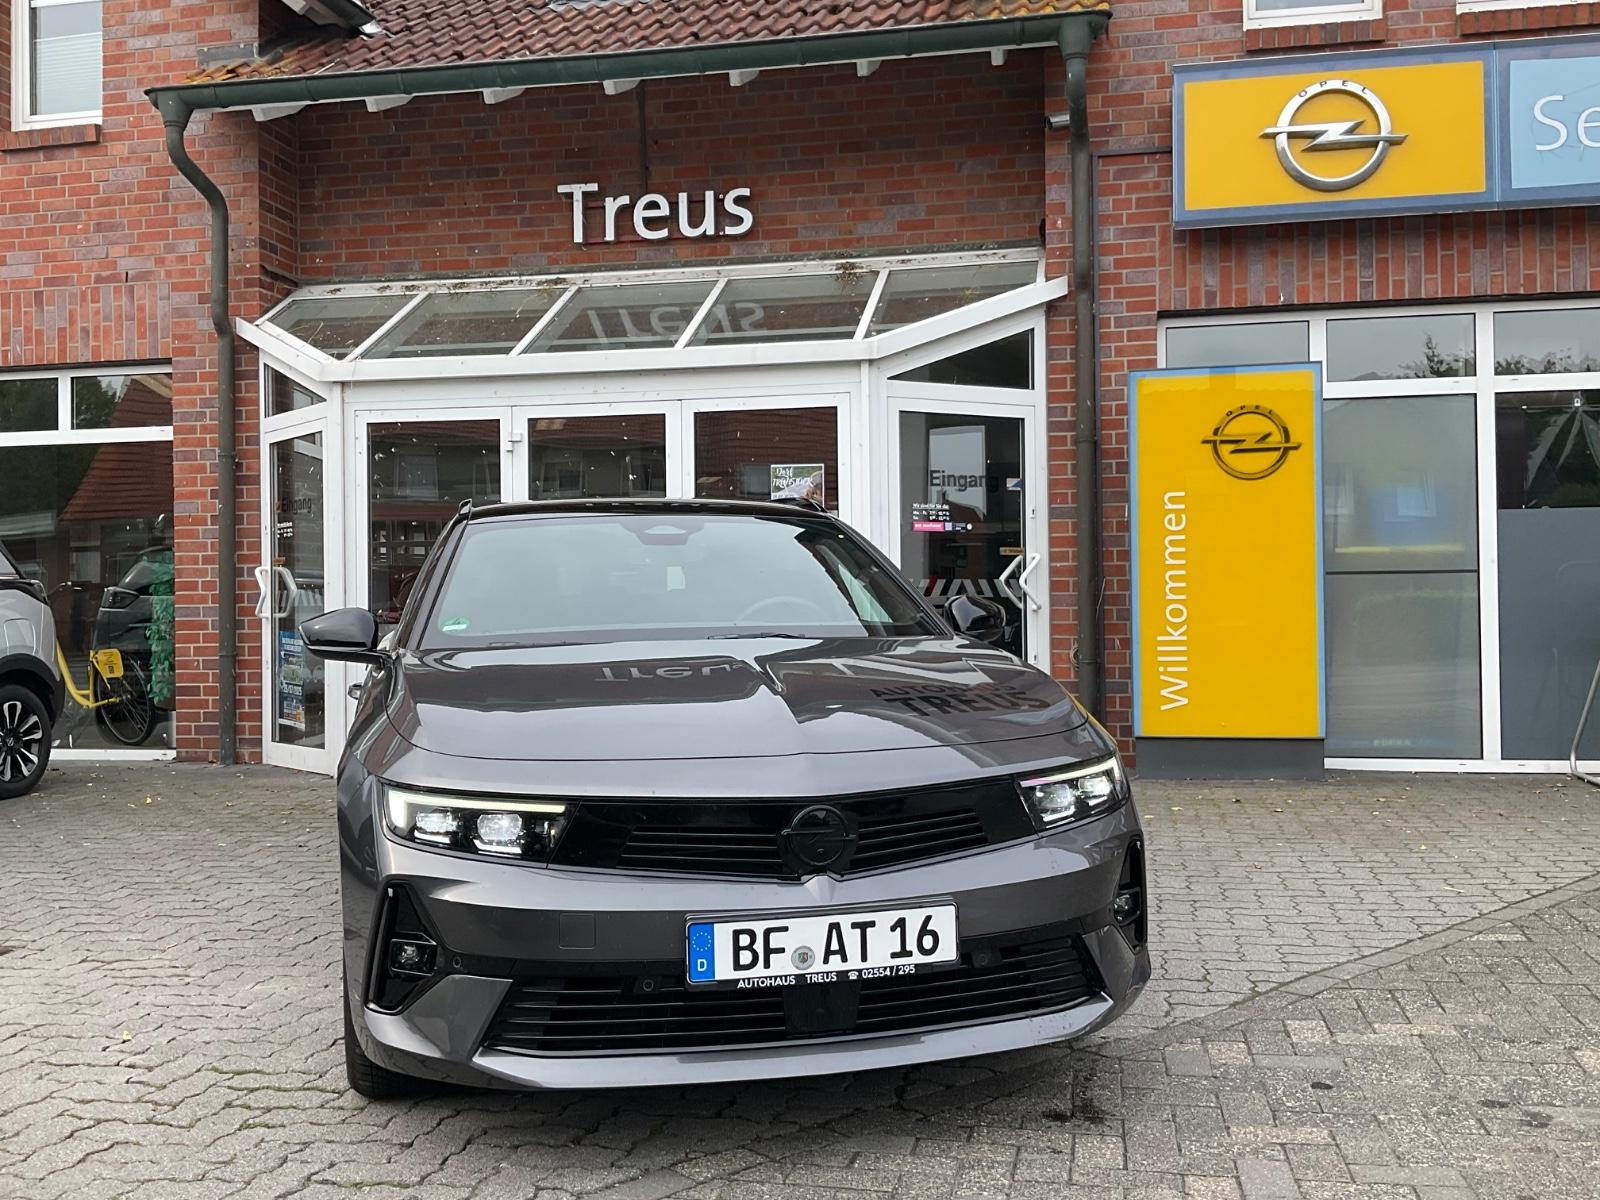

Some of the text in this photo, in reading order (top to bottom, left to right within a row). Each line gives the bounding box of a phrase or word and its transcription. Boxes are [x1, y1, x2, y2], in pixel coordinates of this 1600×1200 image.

[1298, 80, 1369, 98] OPEL
[1533, 95, 1600, 151] Se
[557, 182, 754, 243] Treus
[1156, 491, 1189, 711] Willkommen
[884, 691, 1051, 717] TREUS
[697, 914, 940, 972] D BF AT 16
[737, 975, 796, 989] AUTOHAUS
[805, 972, 837, 984] TREUS
[862, 967, 891, 979] 02554
